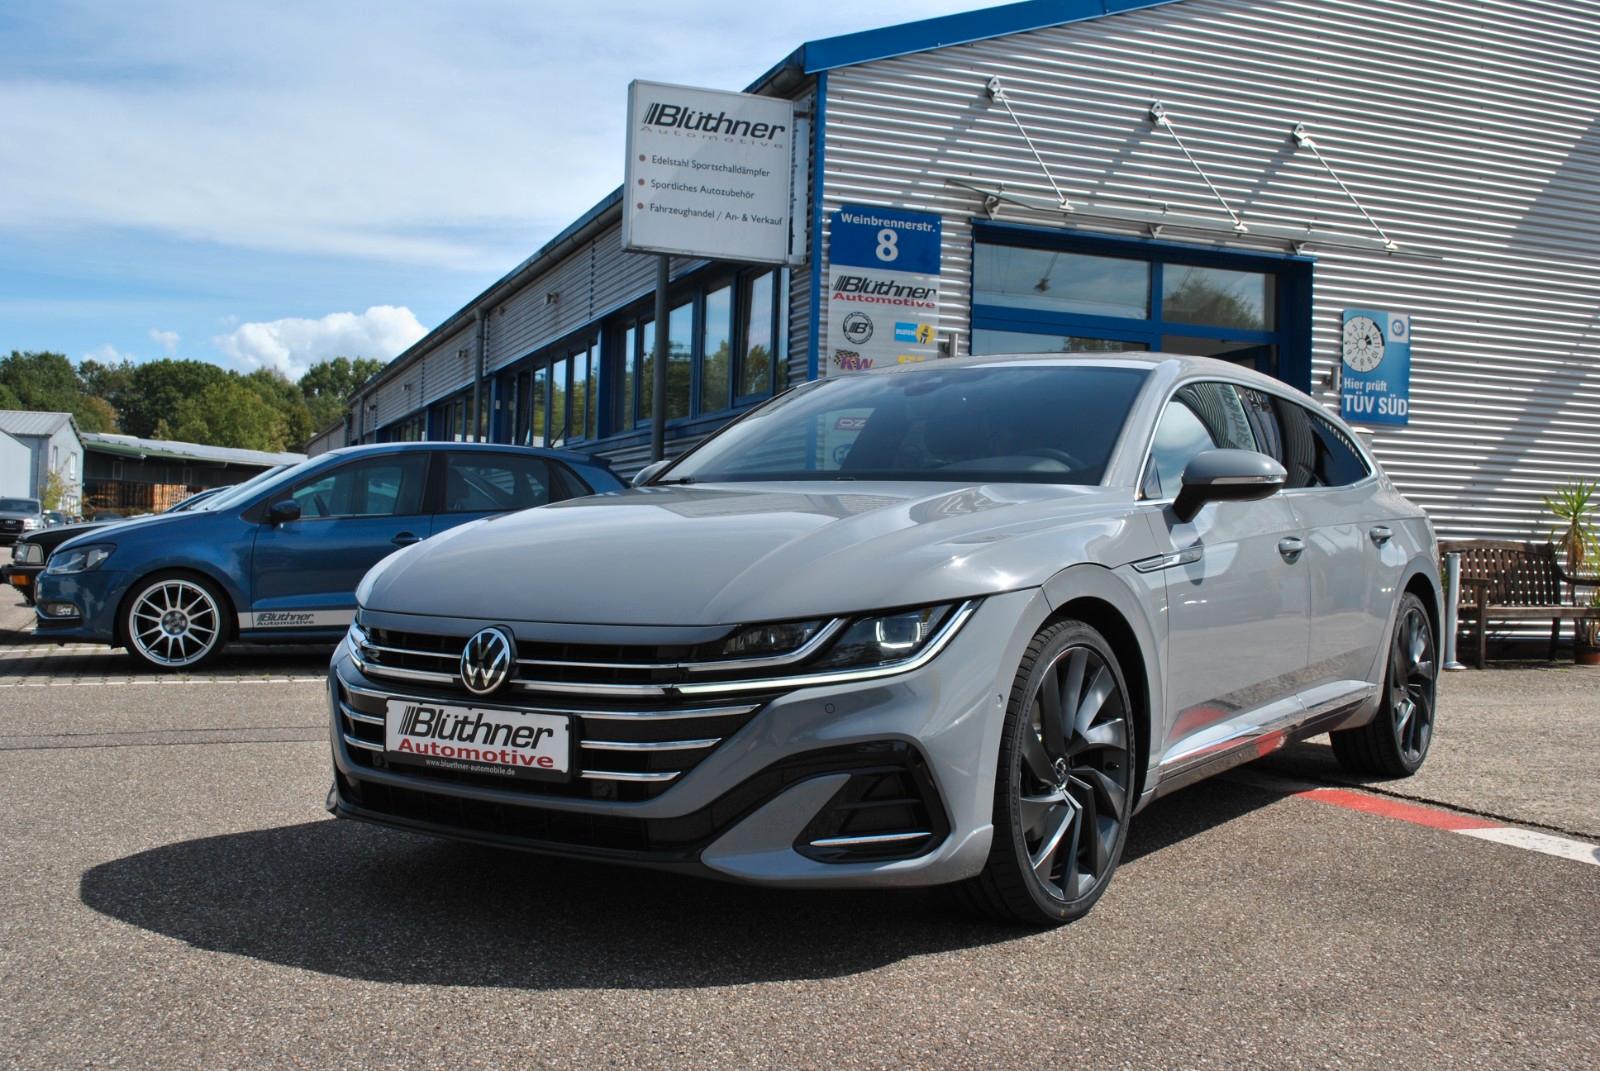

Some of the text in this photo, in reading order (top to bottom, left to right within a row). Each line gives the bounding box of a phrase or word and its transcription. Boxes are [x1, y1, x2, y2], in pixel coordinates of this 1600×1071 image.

[642, 102, 785, 140] Blüthner
[641, 126, 783, 149] Automotive
[652, 155, 770, 177] Edelstahl Sportschalldämpfer
[651, 179, 754, 199] Sportliches Autozubehör
[650, 203, 715, 219] Fahrzeughandel
[725, 211, 739, 220] An-
[742, 213, 748, 222] &
[751, 215, 782, 225] Verkauf
[841, 213, 936, 233] Weinbrennerstr.
[875, 228, 899, 262] 8
[833, 275, 937, 299] Blüthner
[832, 292, 935, 309] Automotive
[1343, 378, 1387, 393] Hier prüft
[1343, 391, 1408, 416] TÜV SÜD
[398, 705, 554, 749] Blüthner
[398, 738, 554, 768] Automotive
[425, 758, 516, 776] www.bluethner-automobile.de
